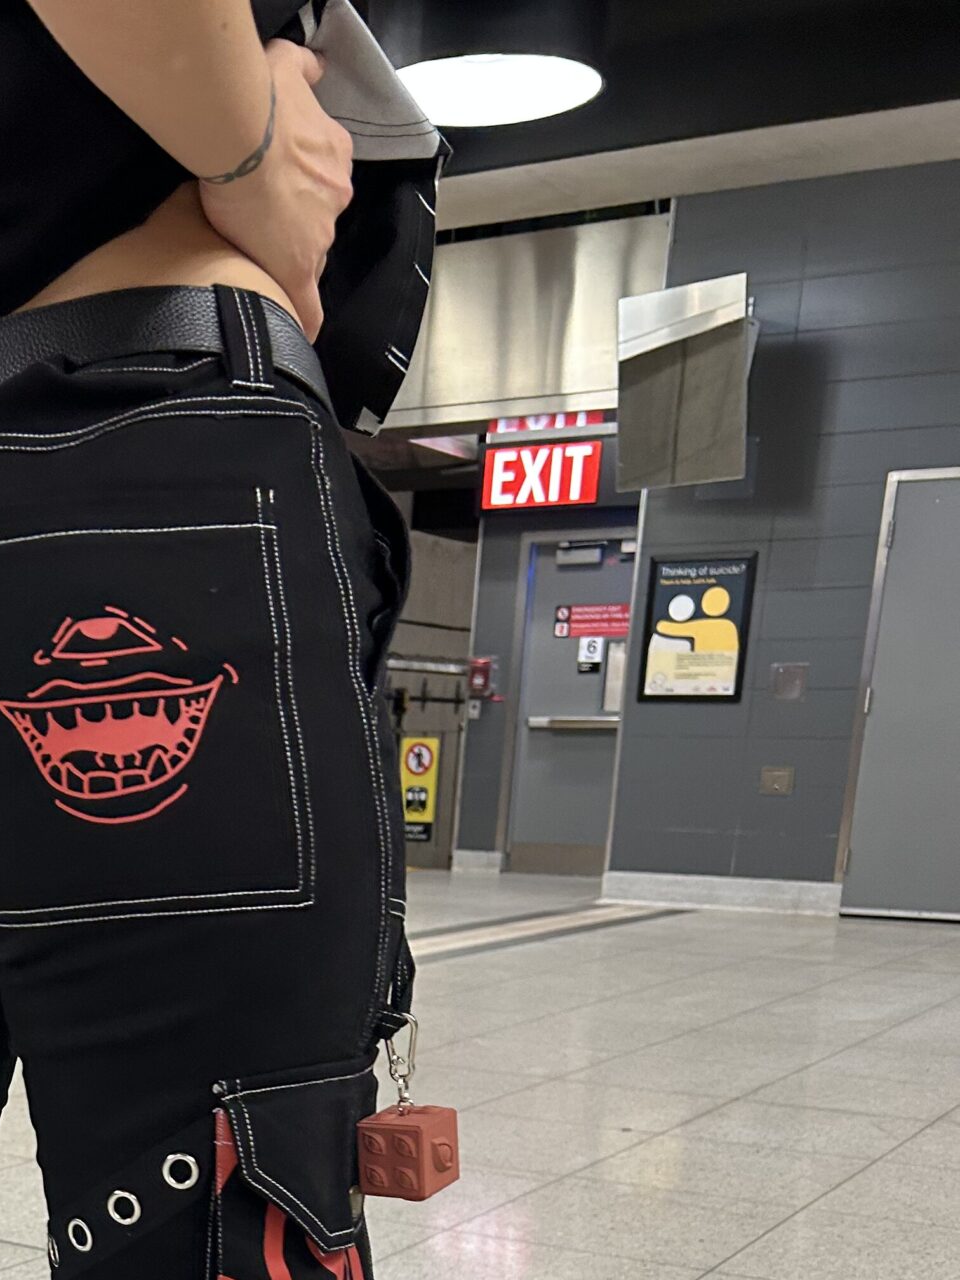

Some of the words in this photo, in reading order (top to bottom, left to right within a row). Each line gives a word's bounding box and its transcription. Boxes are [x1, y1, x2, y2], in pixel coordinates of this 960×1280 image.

[491, 446, 592, 505] EXIT
[662, 566, 697, 577] Thinking
[698, 565, 707, 576] of
[709, 564, 746, 576] suicide?
[587, 639, 598, 654] 6
